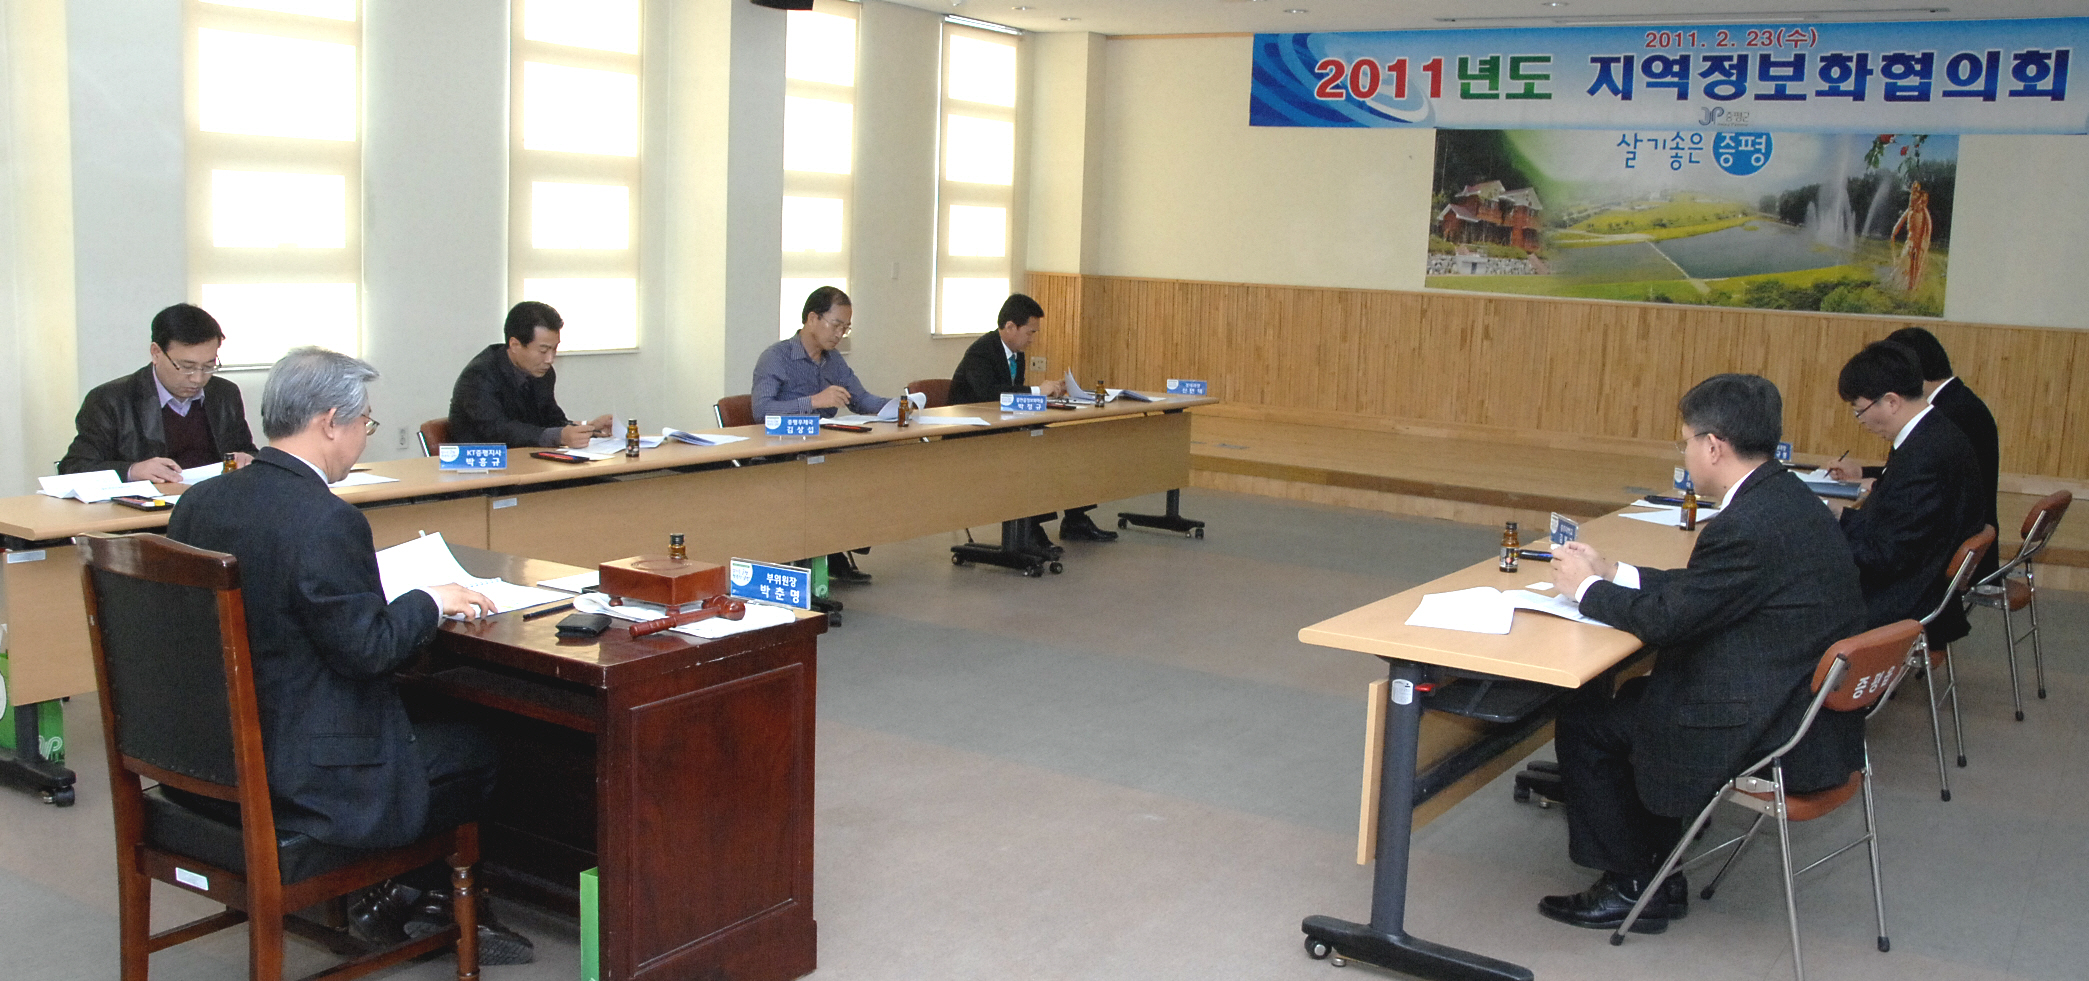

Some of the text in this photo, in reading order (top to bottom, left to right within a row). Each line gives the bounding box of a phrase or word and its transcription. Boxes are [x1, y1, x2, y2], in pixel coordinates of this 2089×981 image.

[1645, 27, 1818, 49] 2011. 2. 23(수)
[1315, 49, 2071, 102] 2011년도 지역정보화협의회
[1719, 132, 1767, 167] 증평
[466, 449, 502, 457] KT증평지사
[766, 573, 797, 588] 부위원장
